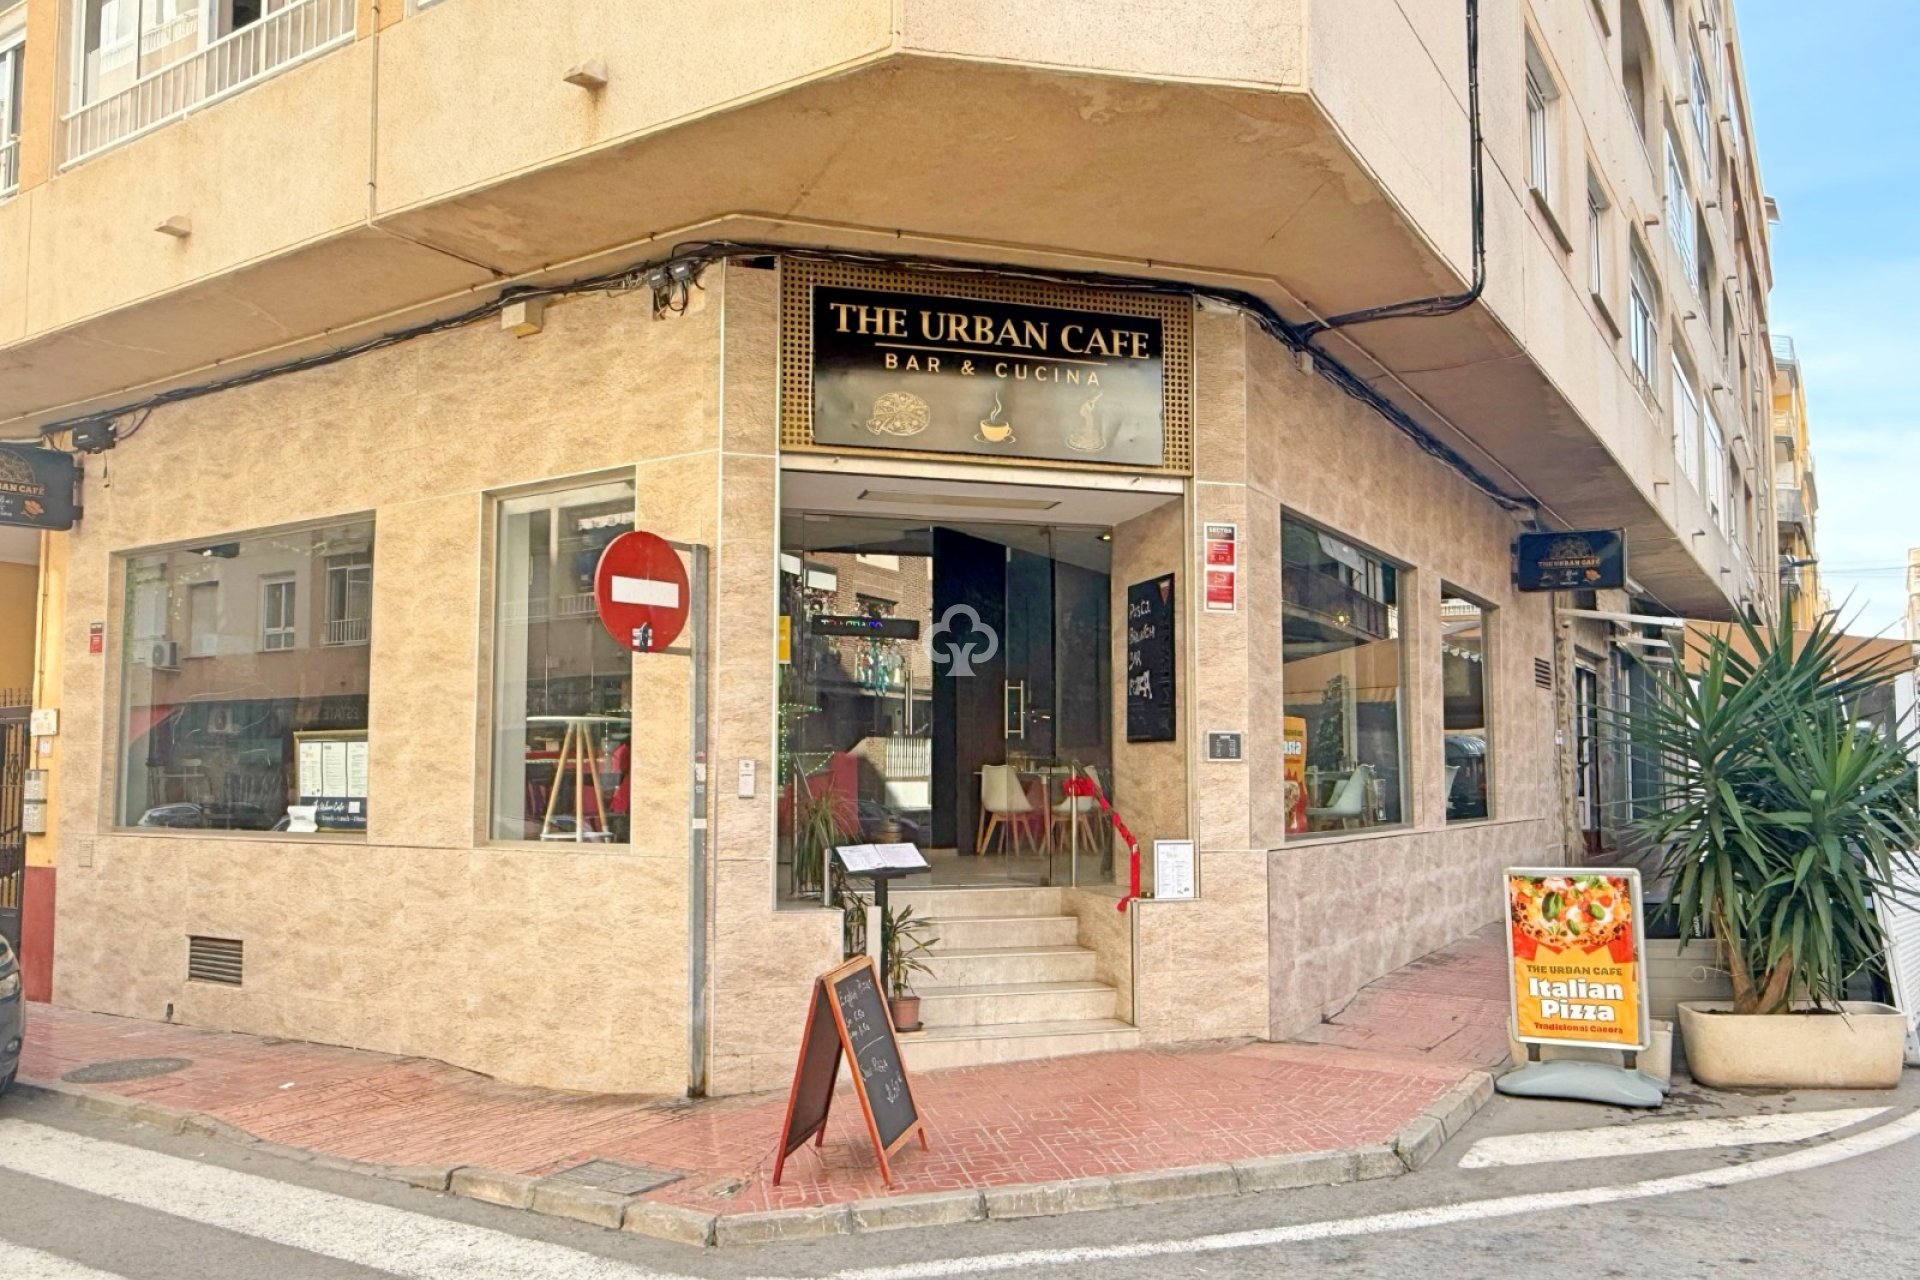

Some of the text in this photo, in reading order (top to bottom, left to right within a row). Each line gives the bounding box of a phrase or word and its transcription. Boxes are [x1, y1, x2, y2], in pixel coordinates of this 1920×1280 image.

[830, 303, 1150, 359] THE URBAN CAFE
[885, 354, 1100, 386] BAR & CUCINA
[1526, 965, 1623, 976] THE URBAN CAFE
[1529, 977, 1624, 1000] Italian
[1541, 999, 1615, 1021] Pizza
